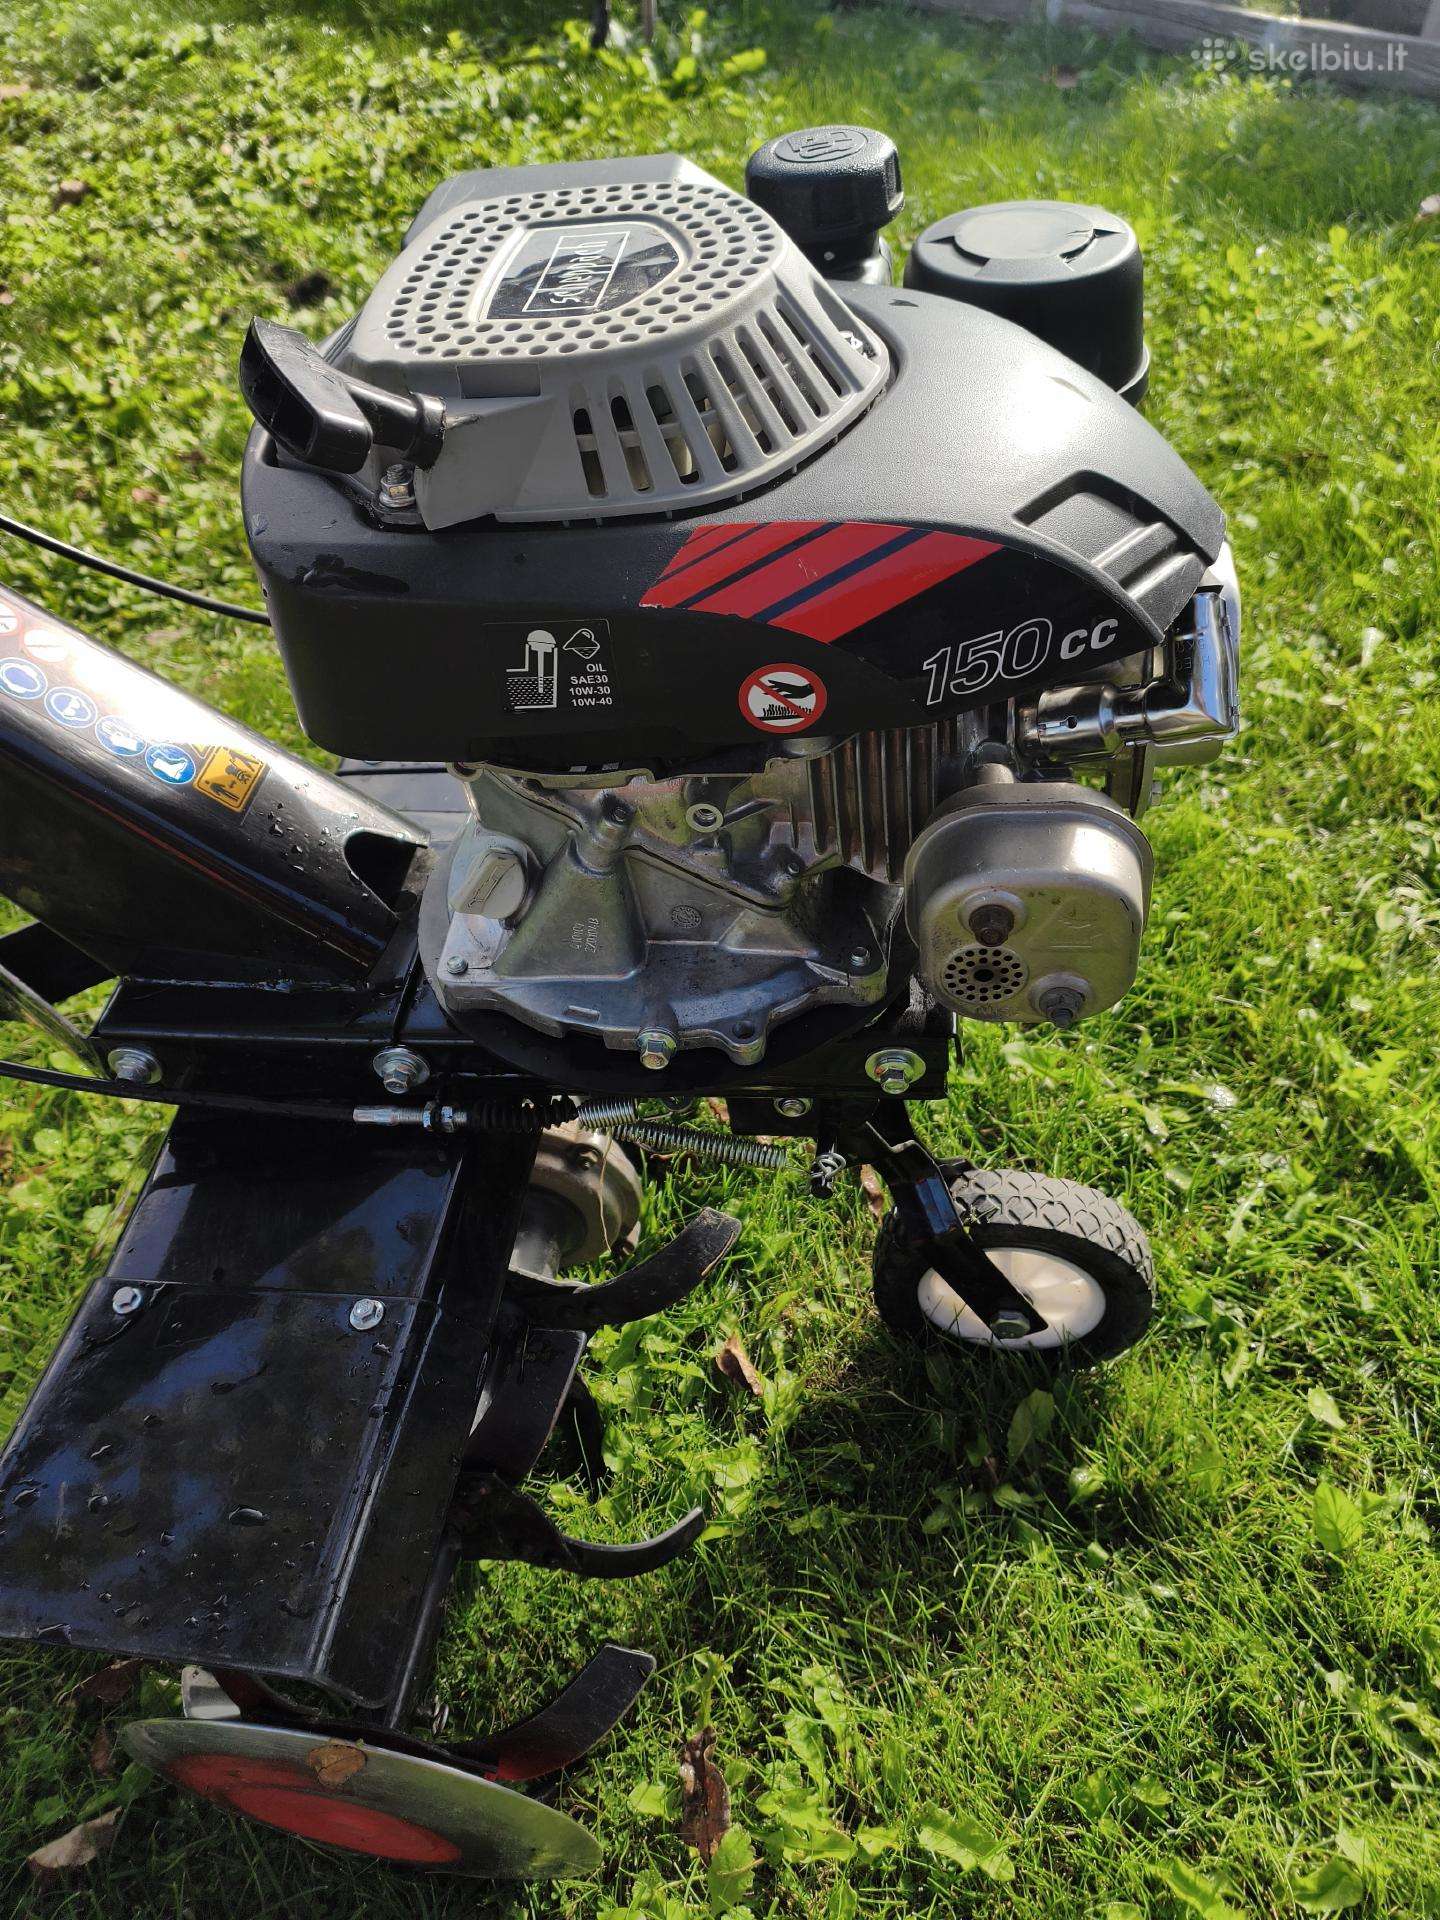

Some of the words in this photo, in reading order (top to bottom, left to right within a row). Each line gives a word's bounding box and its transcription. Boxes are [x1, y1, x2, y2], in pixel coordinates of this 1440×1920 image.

[536, 240, 614, 304] scheppach
[922, 617, 1053, 706] 150
[586, 663, 608, 673] OIL
[570, 675, 609, 685] SAE30
[569, 686, 611, 696] 10W-30
[571, 697, 613, 707] 10W-40
